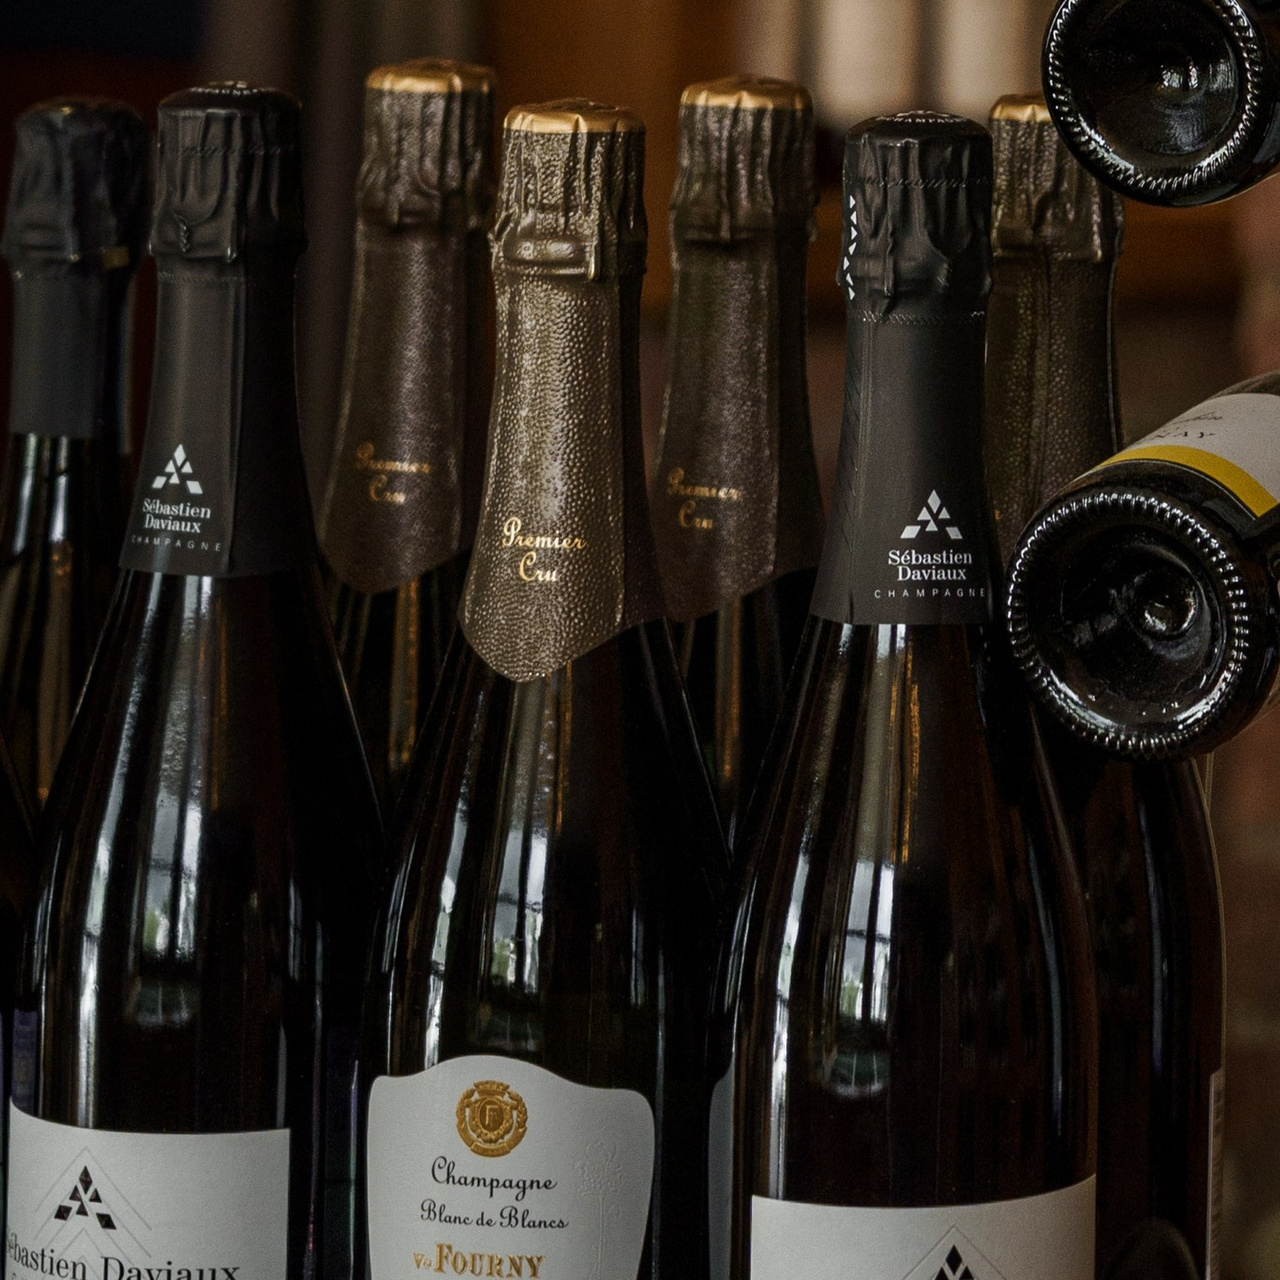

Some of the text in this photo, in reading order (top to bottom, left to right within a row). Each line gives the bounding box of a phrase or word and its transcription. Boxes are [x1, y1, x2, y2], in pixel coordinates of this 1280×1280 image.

[667, 467, 742, 502] Premier
[142, 497, 212, 520] Sébastien
[143, 512, 202, 534] Daviaux
[678, 501, 714, 530] Cru
[131, 534, 223, 553] CHAMPAGNE
[501, 517, 588, 550] Premier
[519, 551, 561, 583] Cru
[887, 549, 973, 566] Sébastien
[896, 566, 967, 582] Daviaux
[874, 587, 986, 599] CHAMPAGNE
[431, 1156, 558, 1201] Champagne
[420, 1198, 569, 1229] Blanc de Blancs
[7, 1232, 240, 1280] ébastien Daviaux
[435, 1242, 545, 1278] FOURNY
